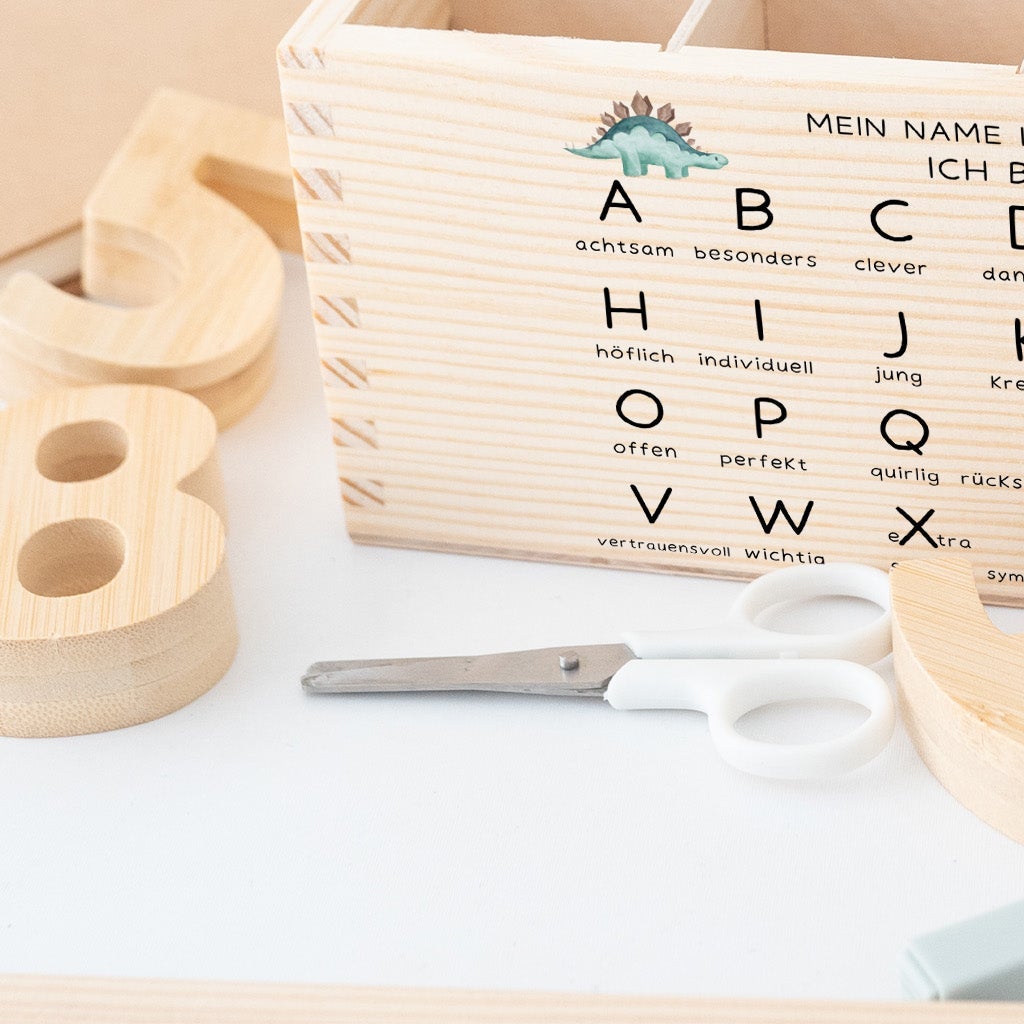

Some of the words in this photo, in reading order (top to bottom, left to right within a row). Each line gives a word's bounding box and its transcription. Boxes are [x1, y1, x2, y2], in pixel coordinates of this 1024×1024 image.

[806, 112, 886, 138] MEIN
[904, 119, 1002, 145] NAME
[928, 156, 988, 182] ICH
[599, 179, 643, 223] A
[735, 187, 774, 231] B
[870, 199, 913, 242] C
[575, 237, 674, 258] achtsam
[694, 246, 817, 268] besonders
[854, 257, 927, 275] clever
[603, 286, 648, 331] H
[754, 299, 764, 342] I
[883, 311, 908, 359] J
[596, 344, 674, 364] höflich
[698, 352, 813, 374] individuell
[874, 366, 922, 388] jung
[615, 388, 664, 429] O
[754, 397, 788, 439] P
[879, 408, 930, 456] Q
[613, 441, 677, 459] offen
[870, 466, 940, 487] quirlig
[629, 484, 673, 524] V
[748, 495, 814, 536] W
[597, 538, 731, 557] vertrauensvoll
